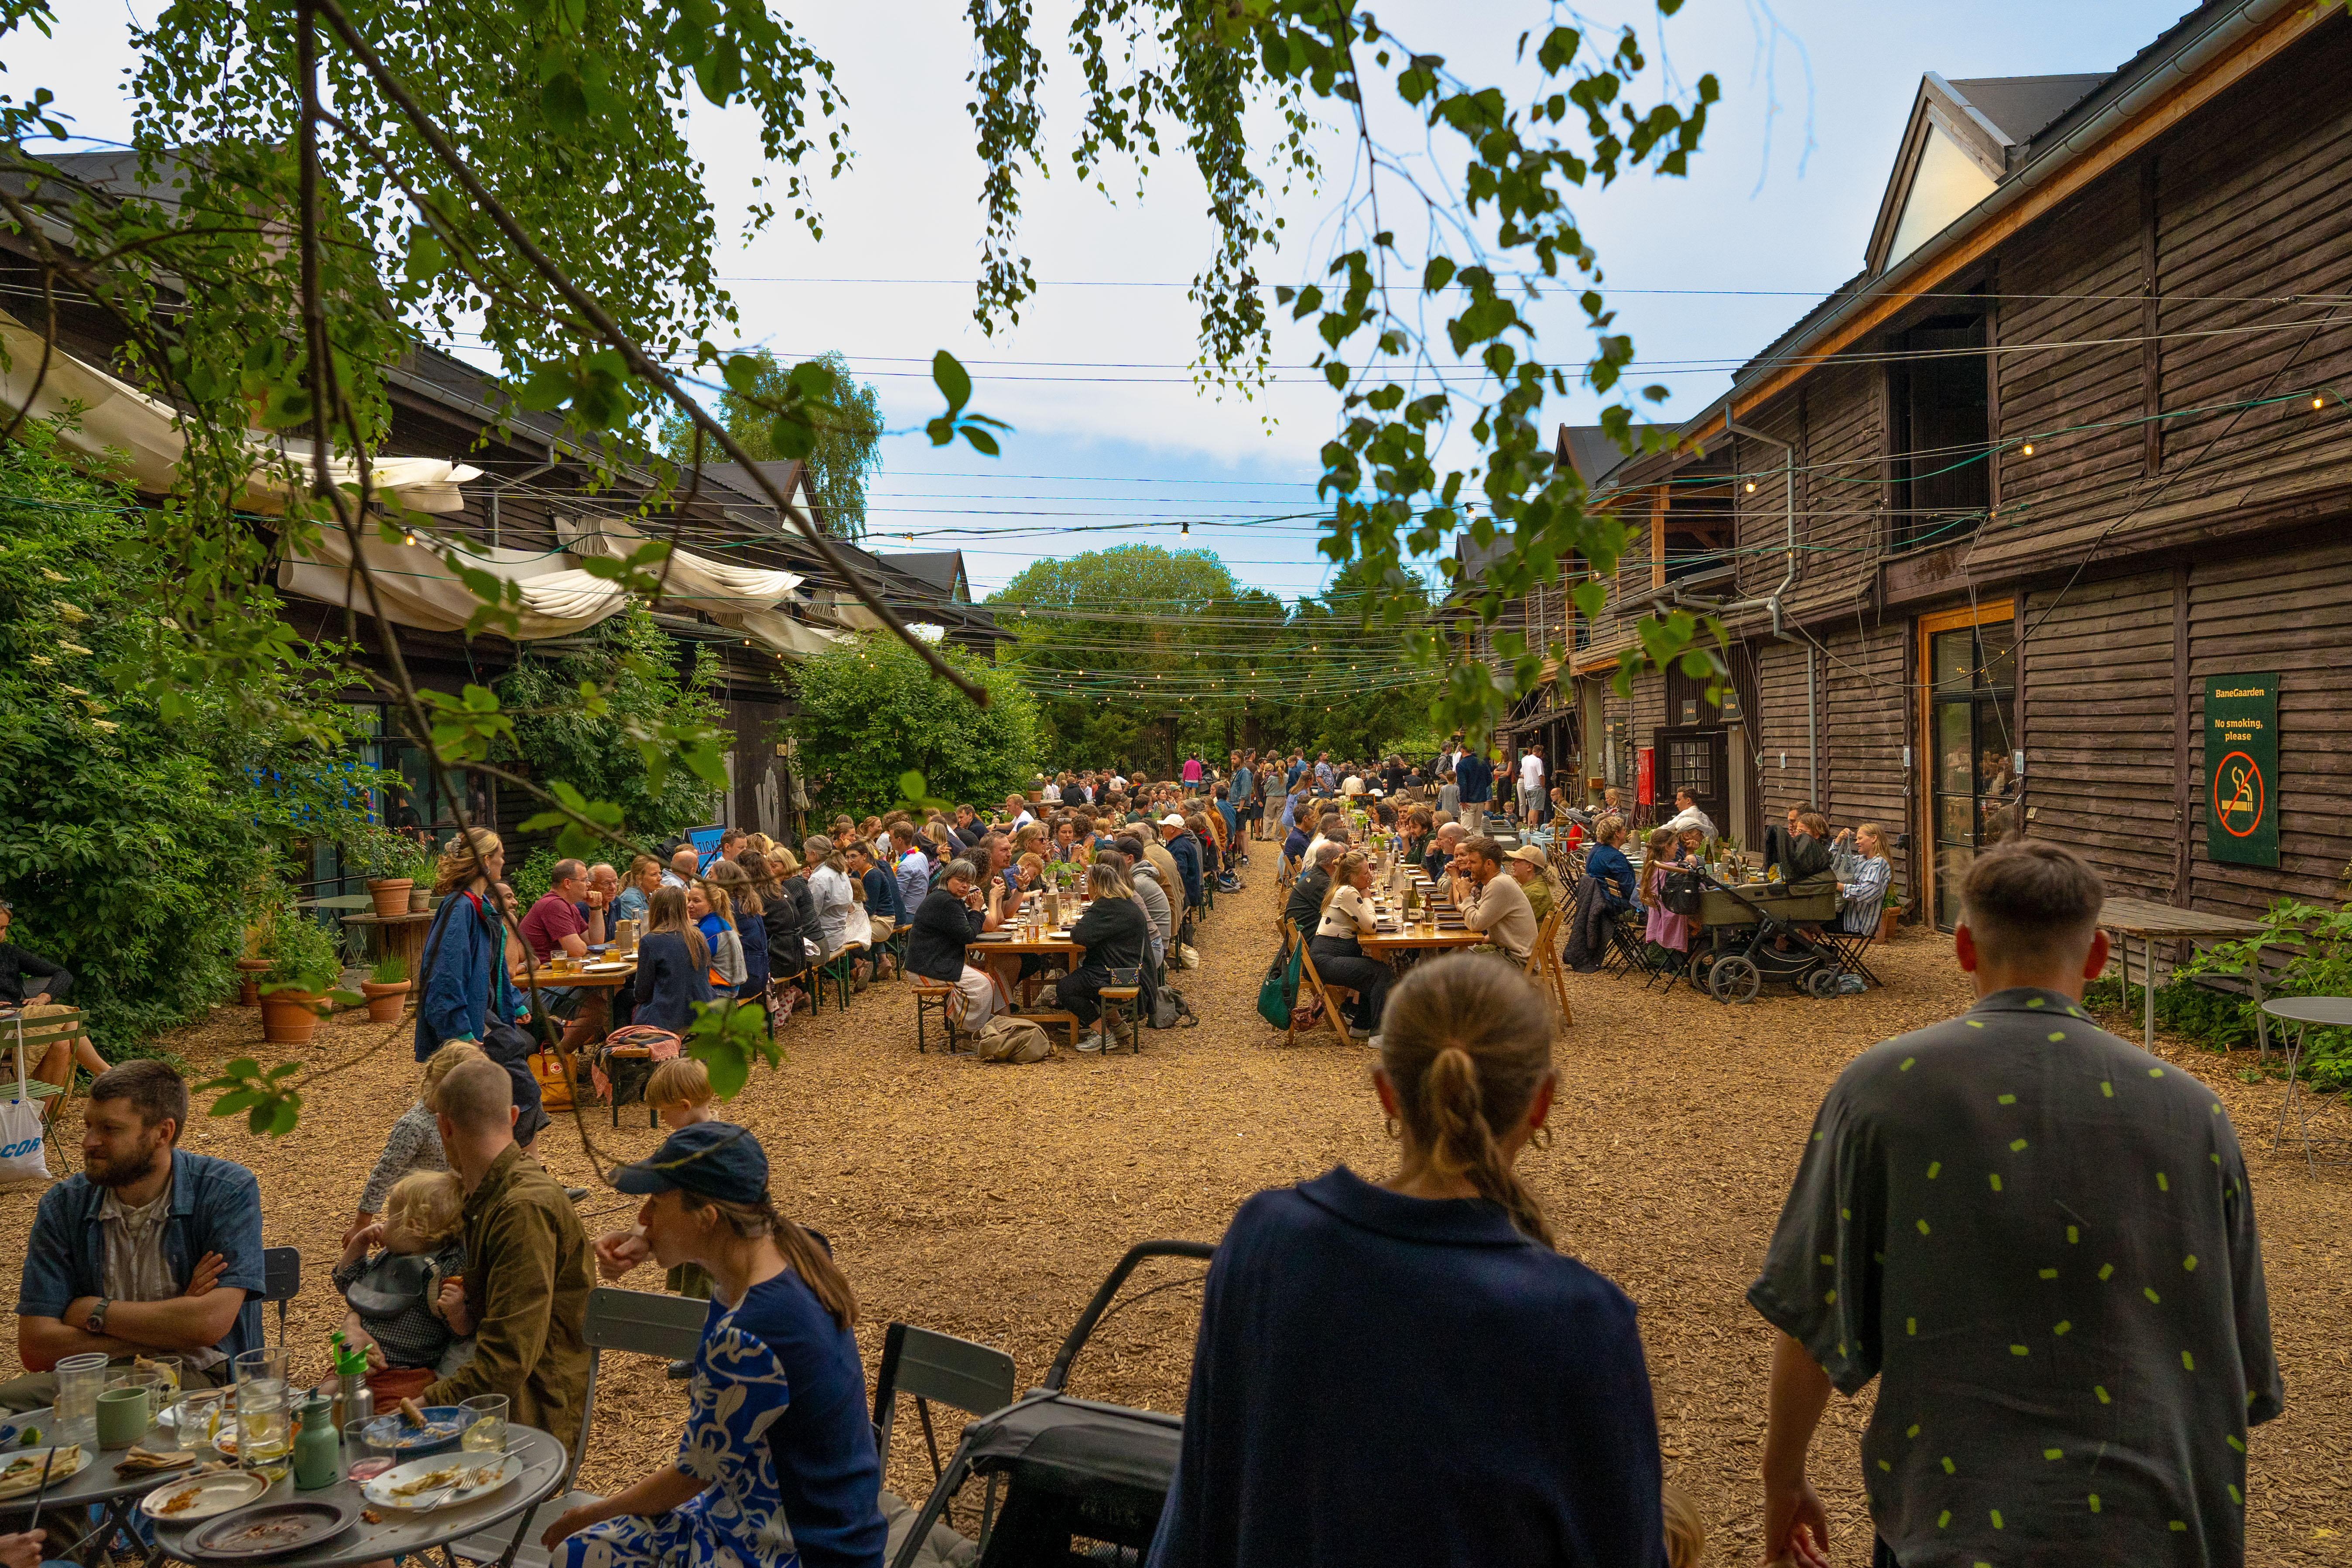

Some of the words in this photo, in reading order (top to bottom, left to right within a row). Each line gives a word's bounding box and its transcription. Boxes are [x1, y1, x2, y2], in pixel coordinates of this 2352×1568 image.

[2215, 687, 2264, 698] BaneGaarden
[2226, 718, 2263, 729] smoking,
[2225, 731, 2251, 742] please
[0, 1137, 41, 1158] COR
